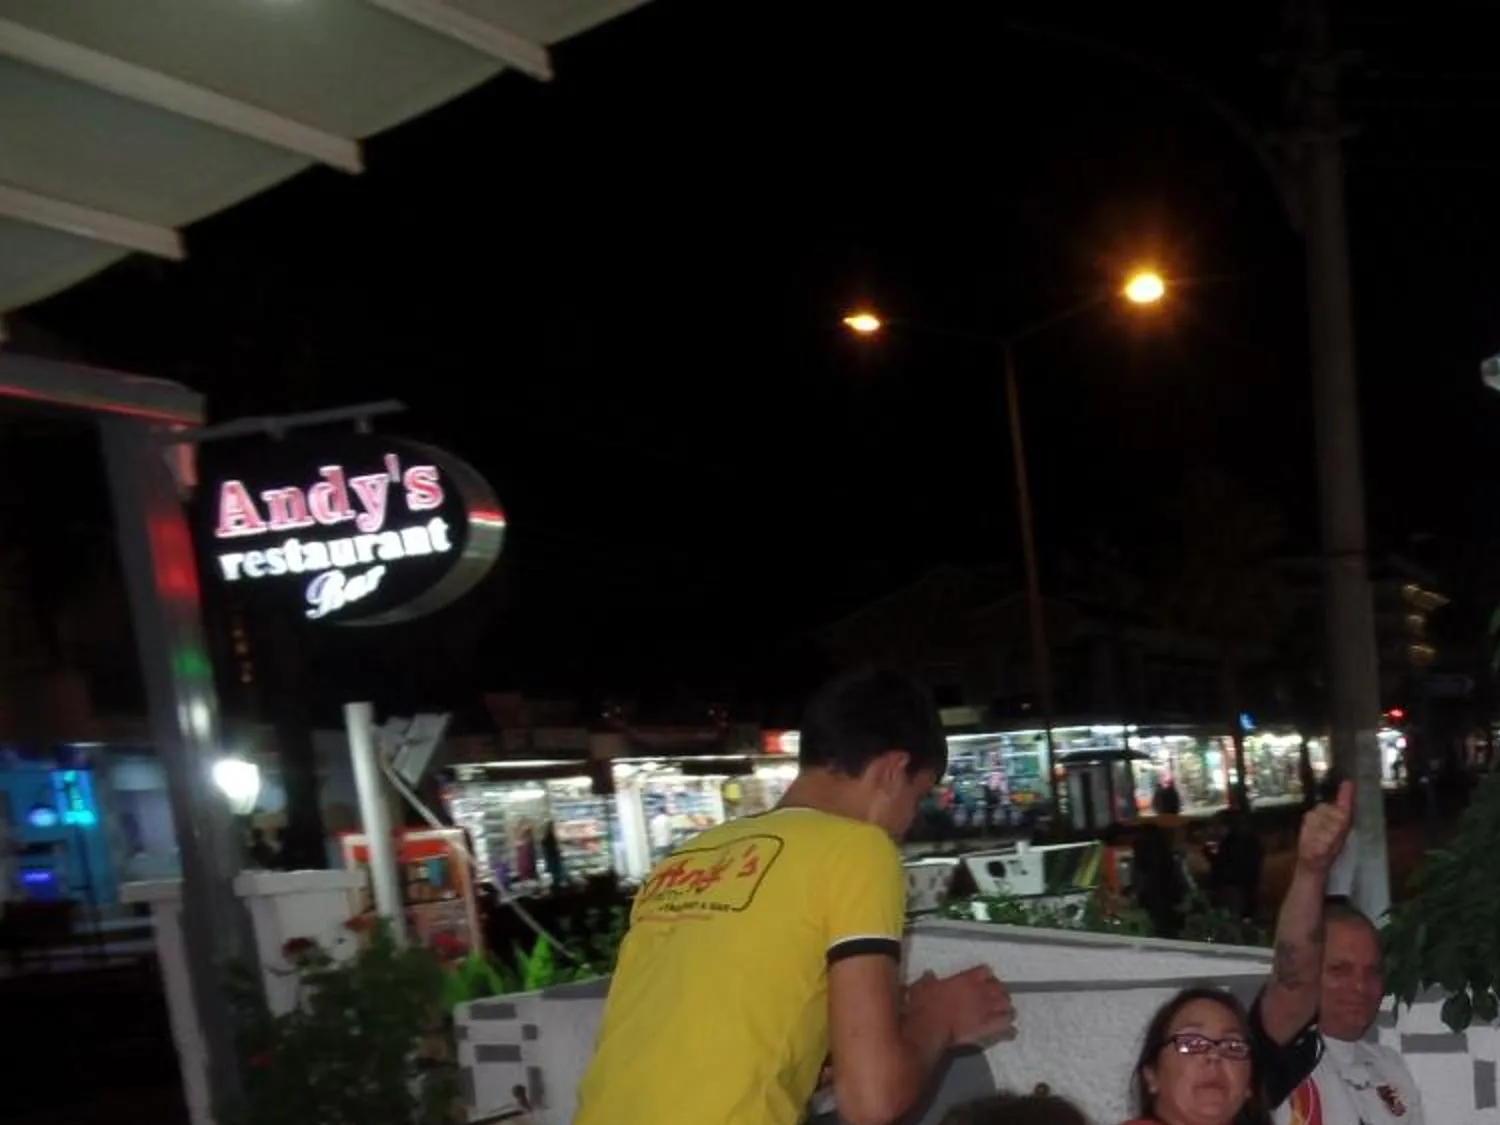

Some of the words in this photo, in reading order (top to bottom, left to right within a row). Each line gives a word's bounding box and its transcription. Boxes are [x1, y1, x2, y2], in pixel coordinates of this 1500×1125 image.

[214, 454, 444, 538] Andy's
[217, 518, 452, 581] restaurant
[304, 566, 386, 619] Bar
